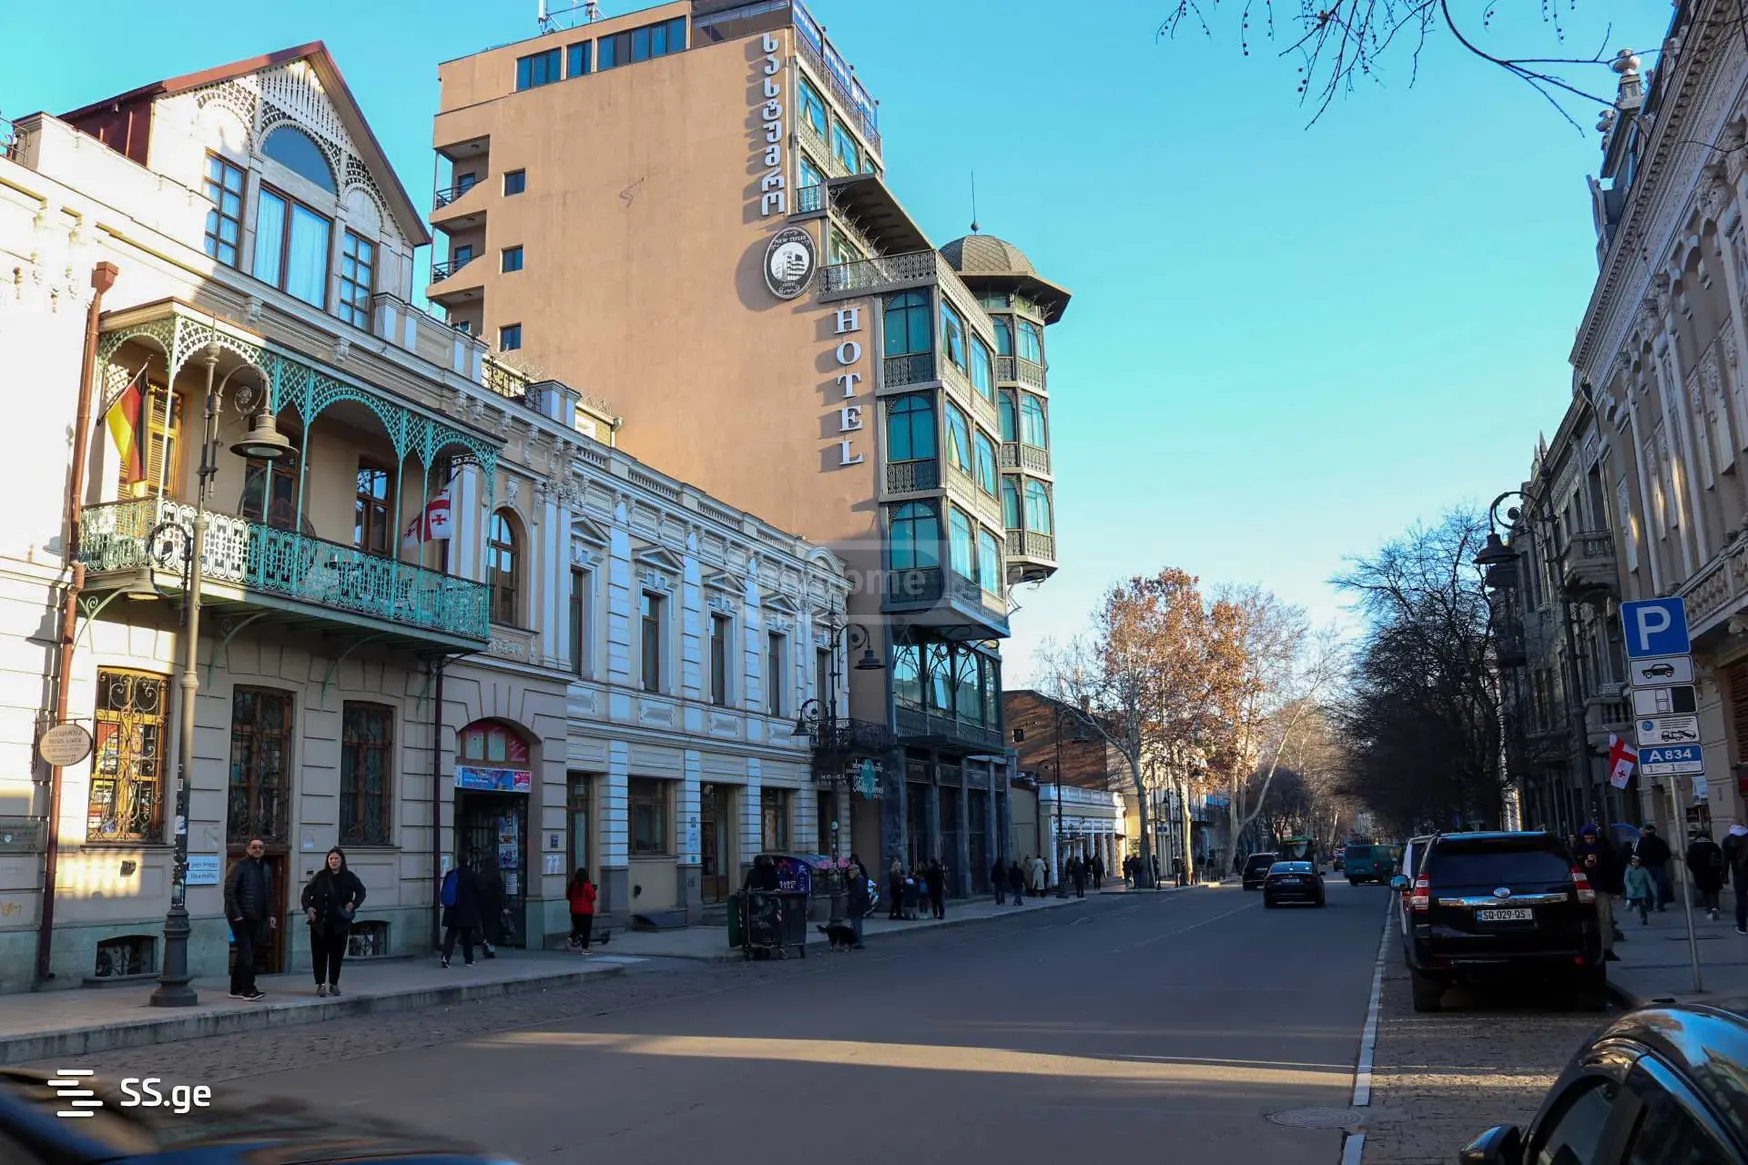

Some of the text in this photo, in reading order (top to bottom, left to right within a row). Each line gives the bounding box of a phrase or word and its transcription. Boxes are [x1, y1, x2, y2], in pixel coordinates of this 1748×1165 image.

[761, 31, 785, 217] სასტუმრო
[834, 307, 864, 467] HOTEL
[1636, 605, 1672, 651] P
[820, 772, 848, 780] HOEL
